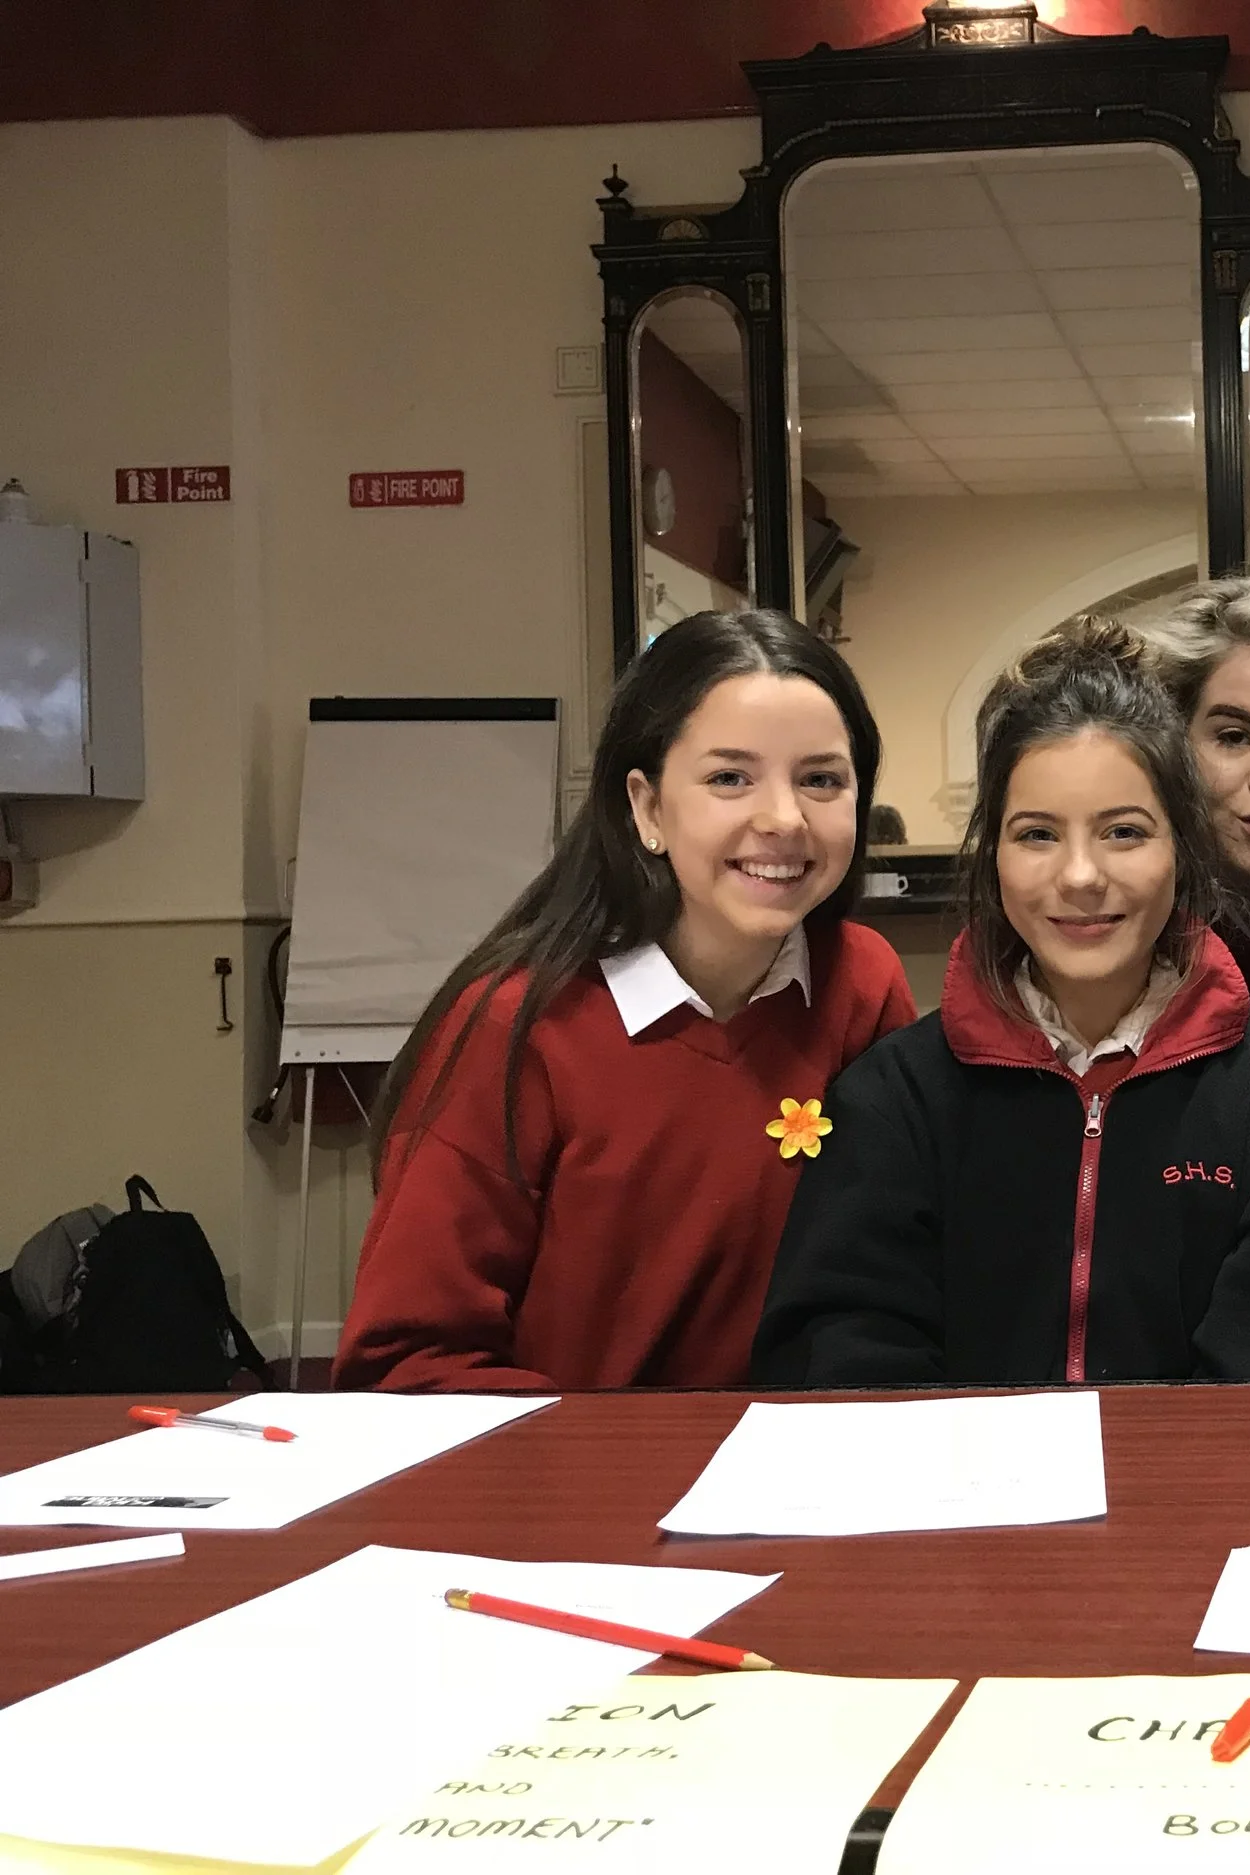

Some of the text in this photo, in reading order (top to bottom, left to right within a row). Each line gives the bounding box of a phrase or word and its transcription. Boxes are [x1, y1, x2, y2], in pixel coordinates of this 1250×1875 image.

[182, 468, 218, 483] Fire
[177, 485, 225, 500] Point
[389, 478, 459, 498] FIRE POINT
[433, 1781, 533, 1796] AND
